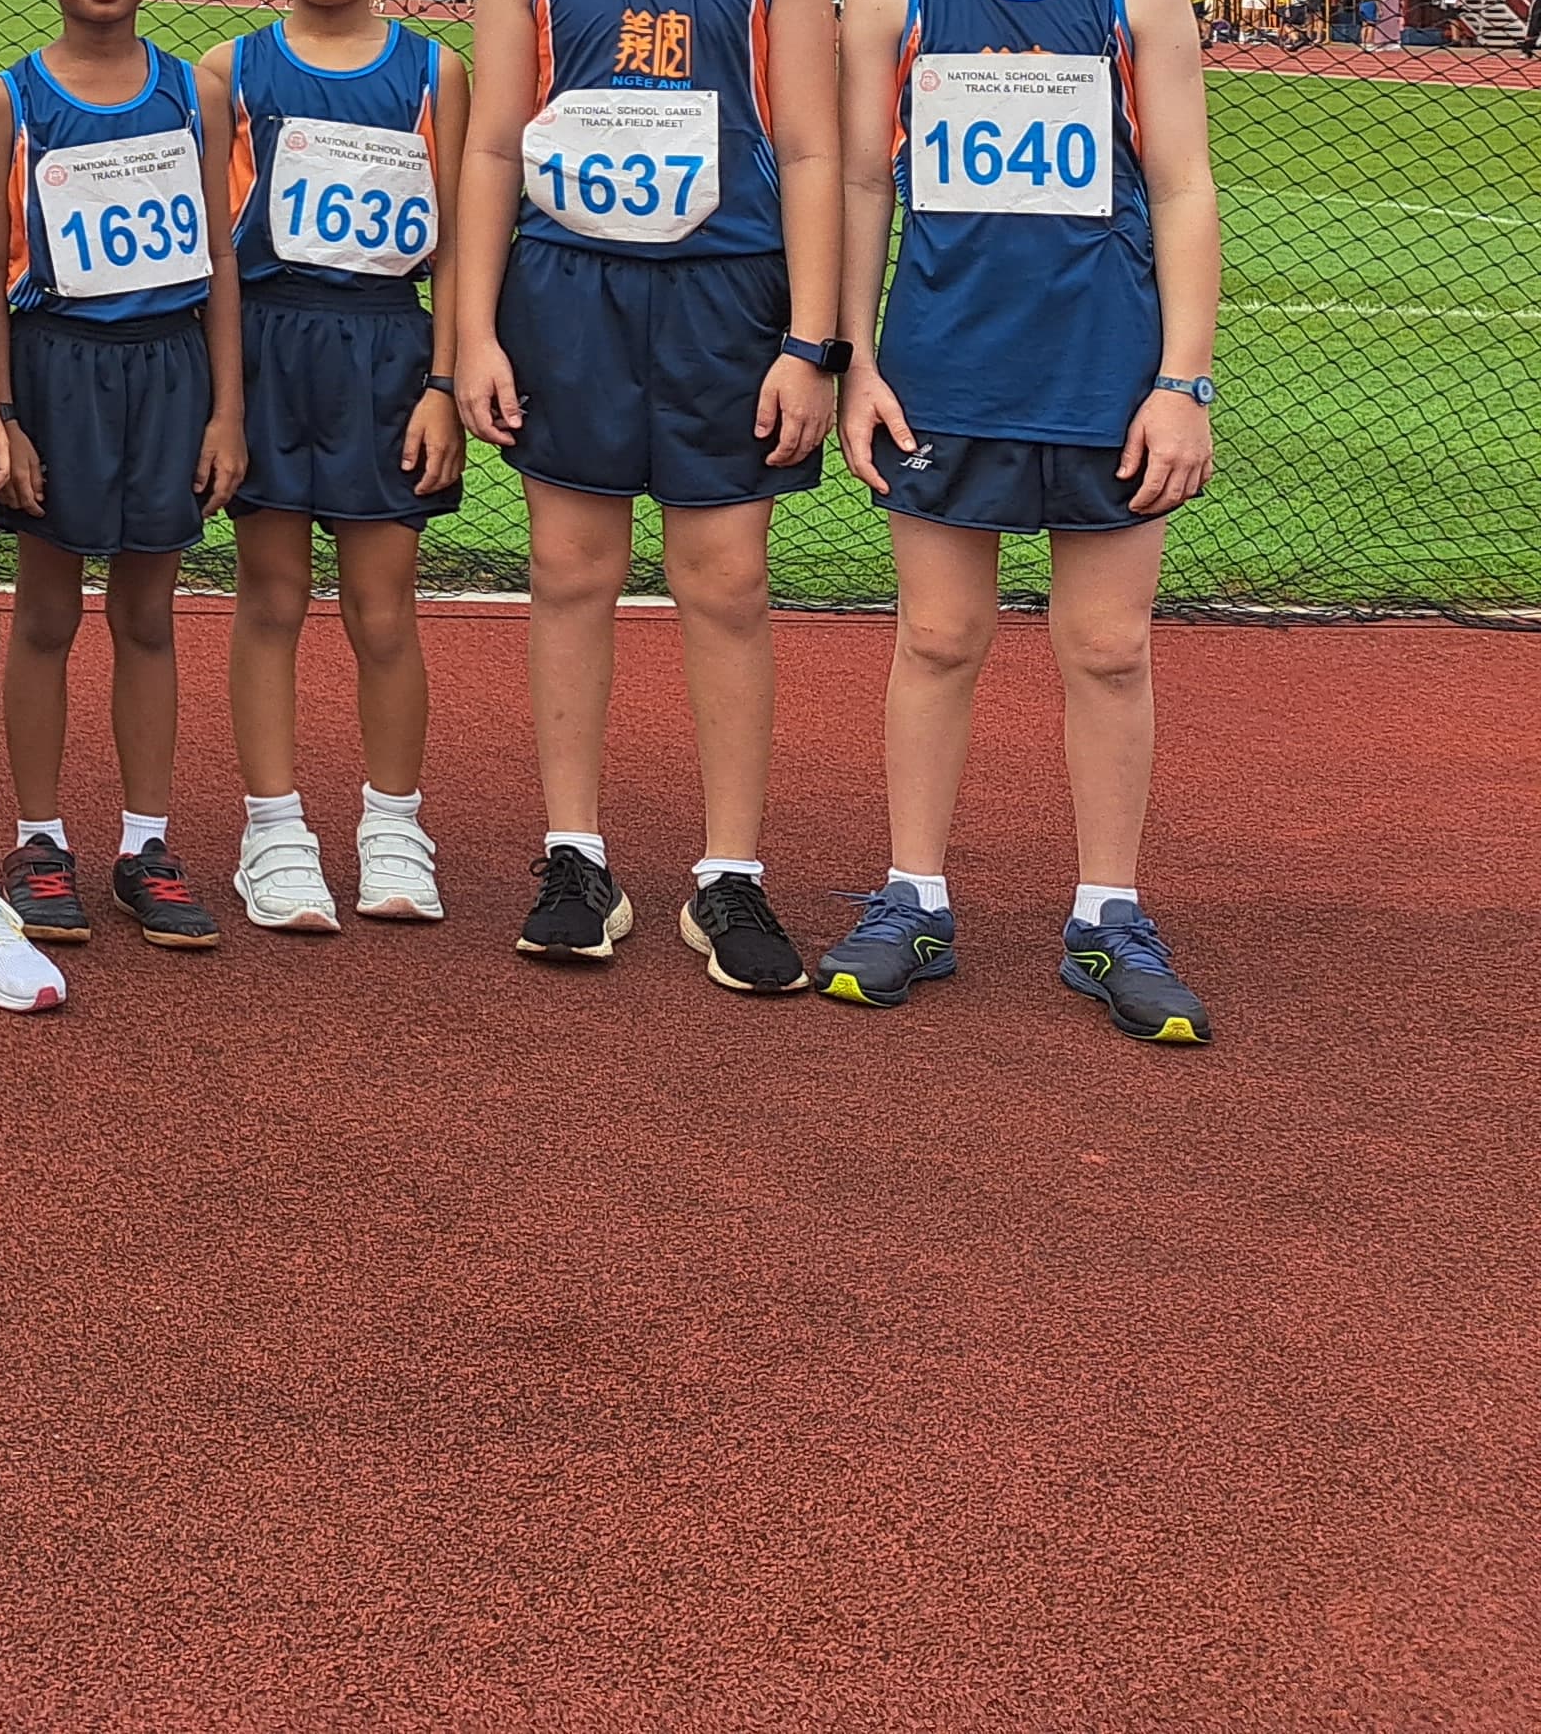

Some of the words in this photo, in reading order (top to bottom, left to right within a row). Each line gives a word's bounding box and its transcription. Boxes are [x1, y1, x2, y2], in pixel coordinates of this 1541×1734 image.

[612, 75, 654, 88] NGEE
[657, 79, 691, 90] ANN
[947, 72, 999, 81] NATIONAL
[1004, 72, 1051, 82] SCHOOL
[1056, 73, 1094, 83] GAMES
[965, 84, 1001, 93] TRACK
[1003, 84, 1010, 93] &
[1013, 84, 1044, 94] FIELD
[1047, 85, 1076, 95] MEET
[563, 106, 612, 115] NATIONAL
[617, 106, 659, 116] SCHOOL
[664, 107, 702, 117] GAMES
[581, 118, 614, 128] TRACK
[615, 119, 623, 127] &
[625, 118, 653, 128] FIELD
[656, 119, 685, 128] MEET
[315, 135, 360, 149] NATIONAL
[365, 142, 403, 156] SCHOOL
[924, 120, 1097, 189] 1640
[73, 158, 118, 172] NATIONAL
[123, 153, 158, 164] SCHOOL
[161, 146, 186, 159] GAMES
[329, 149, 361, 161] TRACK
[361, 154, 368, 162] &
[370, 154, 396, 166] FIELD
[398, 159, 423, 171] MEET
[92, 170, 122, 182] TRACK
[124, 168, 131, 177] &
[132, 163, 155, 176] FIELD
[156, 160, 177, 171] MEET
[539, 152, 704, 216] 1637
[282, 177, 430, 255] 1636
[61, 193, 198, 272] 1639
